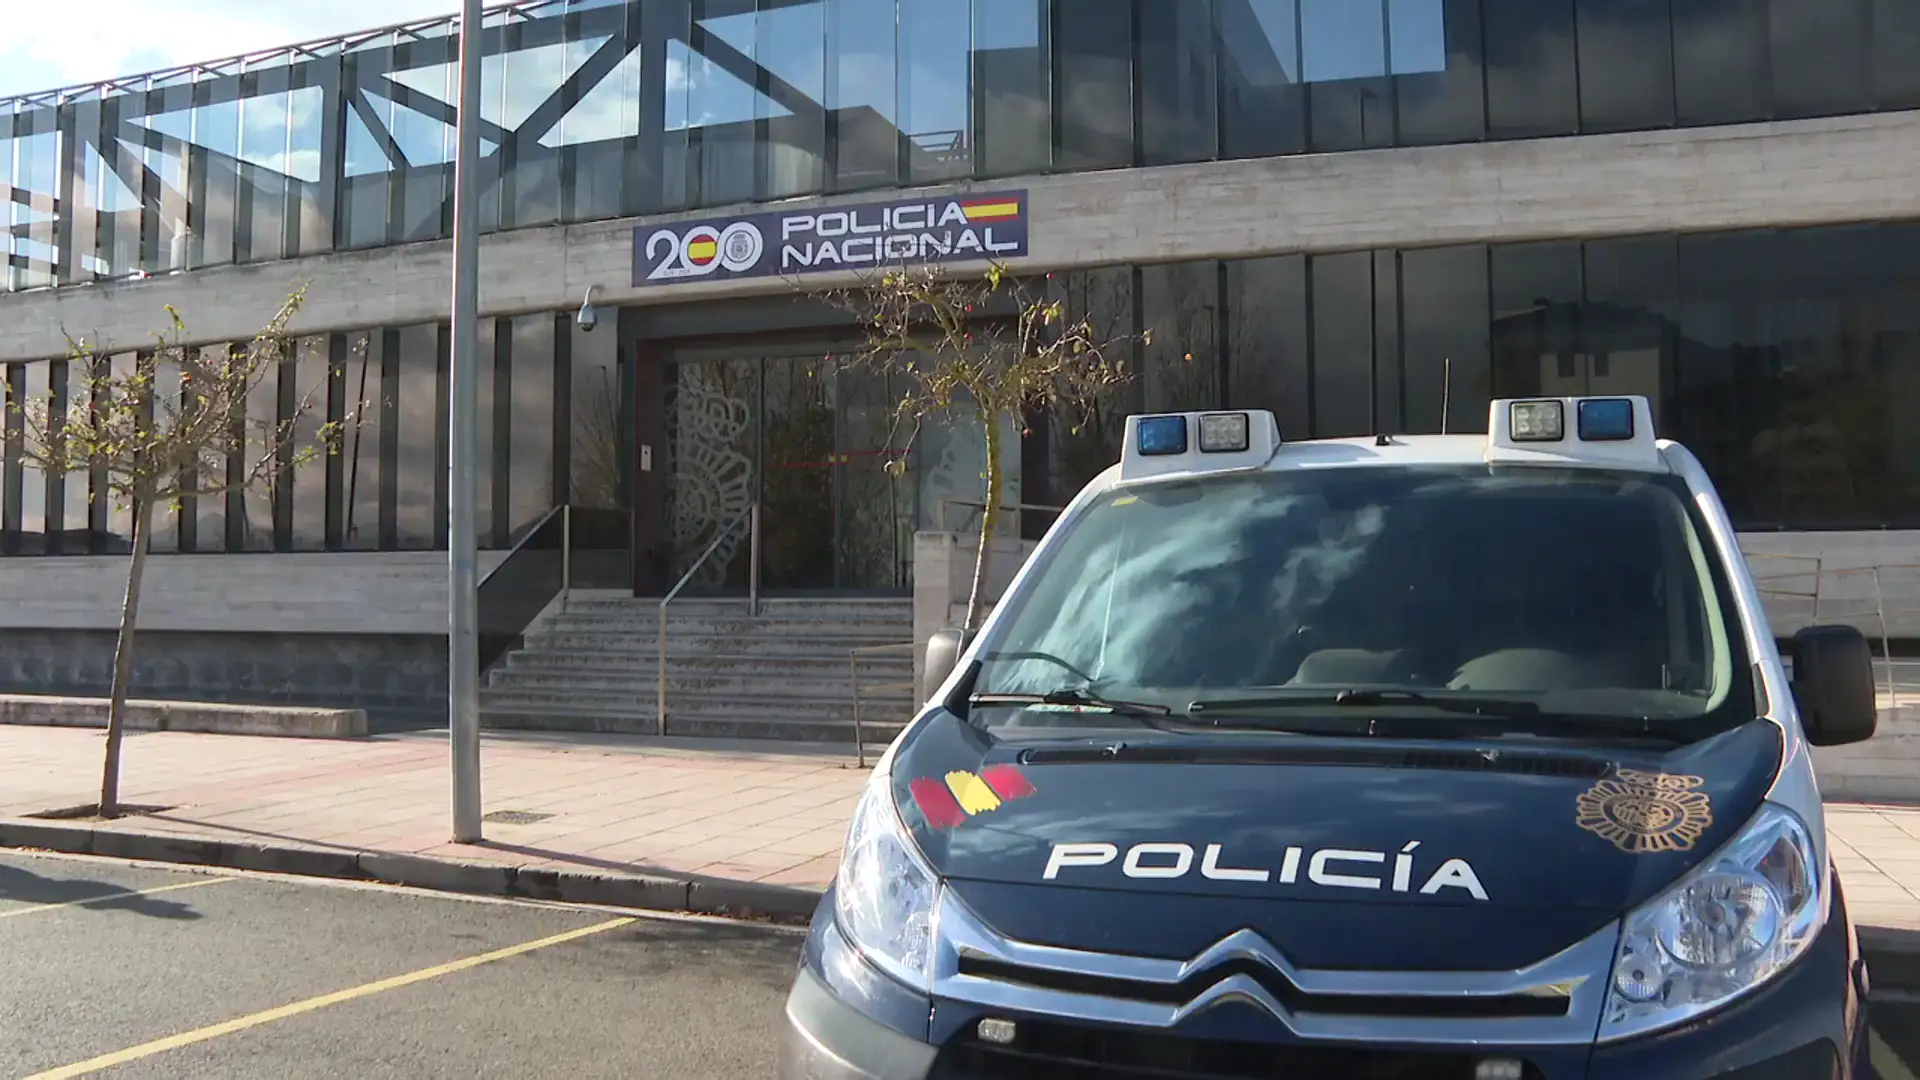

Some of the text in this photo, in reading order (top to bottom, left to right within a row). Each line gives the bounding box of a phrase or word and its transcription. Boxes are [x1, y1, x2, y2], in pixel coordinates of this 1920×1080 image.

[646, 221, 763, 280] 200
[782, 227, 1018, 268] NACIONAL
[1042, 841, 1490, 901] POLICÍA
